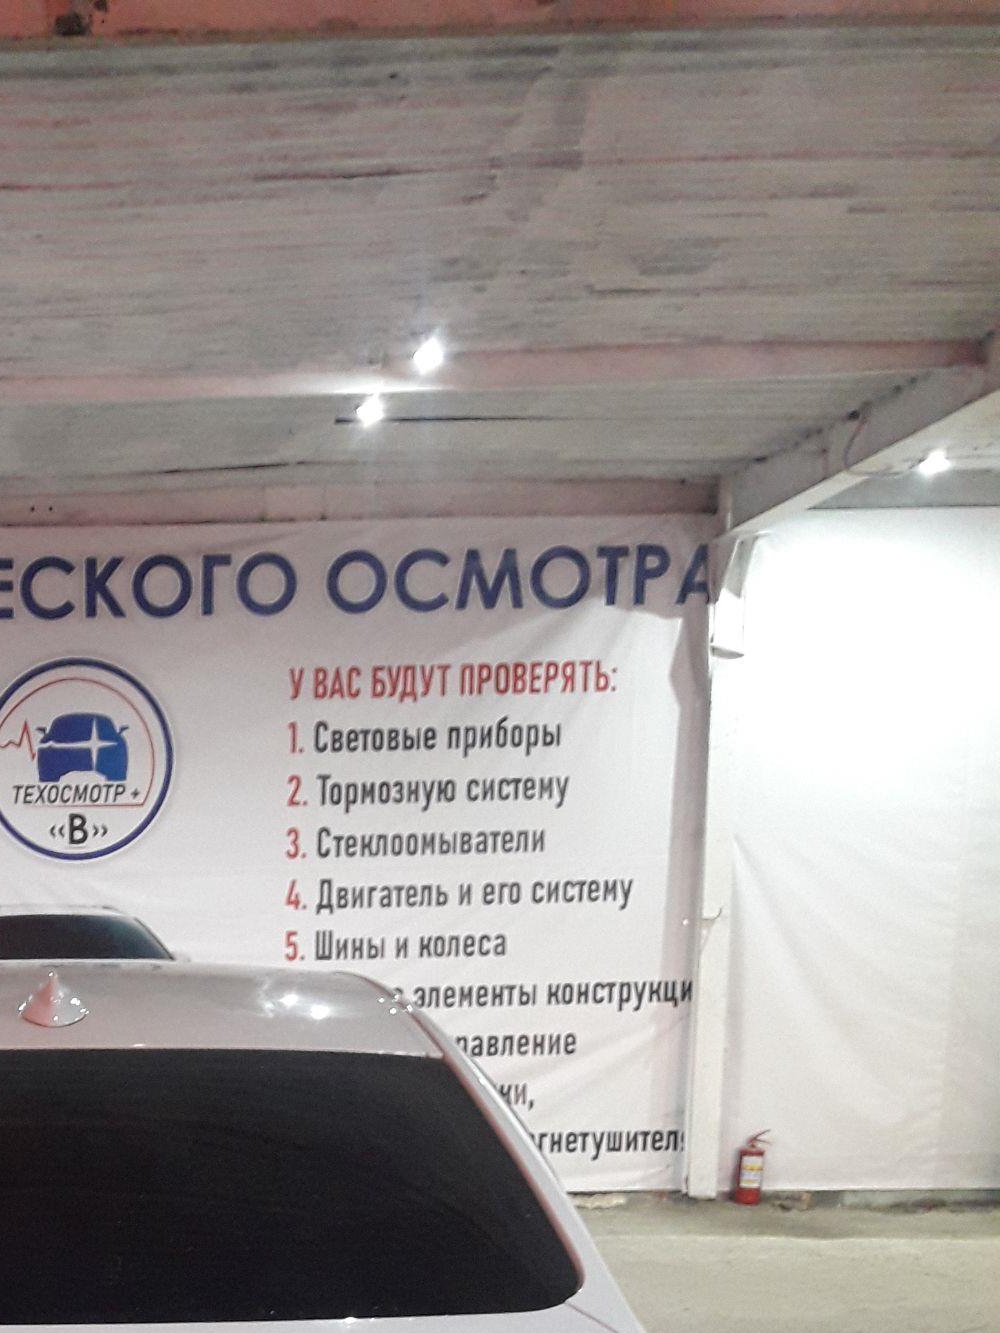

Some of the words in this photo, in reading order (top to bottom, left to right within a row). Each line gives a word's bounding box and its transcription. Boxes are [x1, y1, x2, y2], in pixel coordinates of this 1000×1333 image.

[326, 544, 710, 614] ОСМОТРА
[289, 668, 305, 700] У
[313, 667, 362, 699] ВАС
[370, 663, 451, 703] БУДУТ
[459, 660, 618, 696] ПРОВЕРЯТЬ:
[287, 722, 304, 753] 1.
[313, 718, 437, 754] Световые
[446, 716, 562, 757] приборы
[12, 784, 126, 804] ТЕХОСМОТР
[286, 776, 308, 807] 2.
[317, 773, 456, 813] Тормозную
[466, 774, 570, 809] систему
[285, 829, 307, 860] 3.
[316, 825, 546, 858] Стеклоомыватели
[284, 880, 307, 910] 4.
[315, 877, 448, 914] Двигатель
[457, 881, 473, 905] и
[482, 880, 523, 908] его
[531, 877, 634, 910] систему
[284, 931, 306, 960] 5.
[314, 928, 386, 960] Шины
[394, 934, 409, 958] и
[418, 930, 508, 960] колеса
[413, 984, 537, 1009] элементы
[455, 1030, 578, 1058] равление
